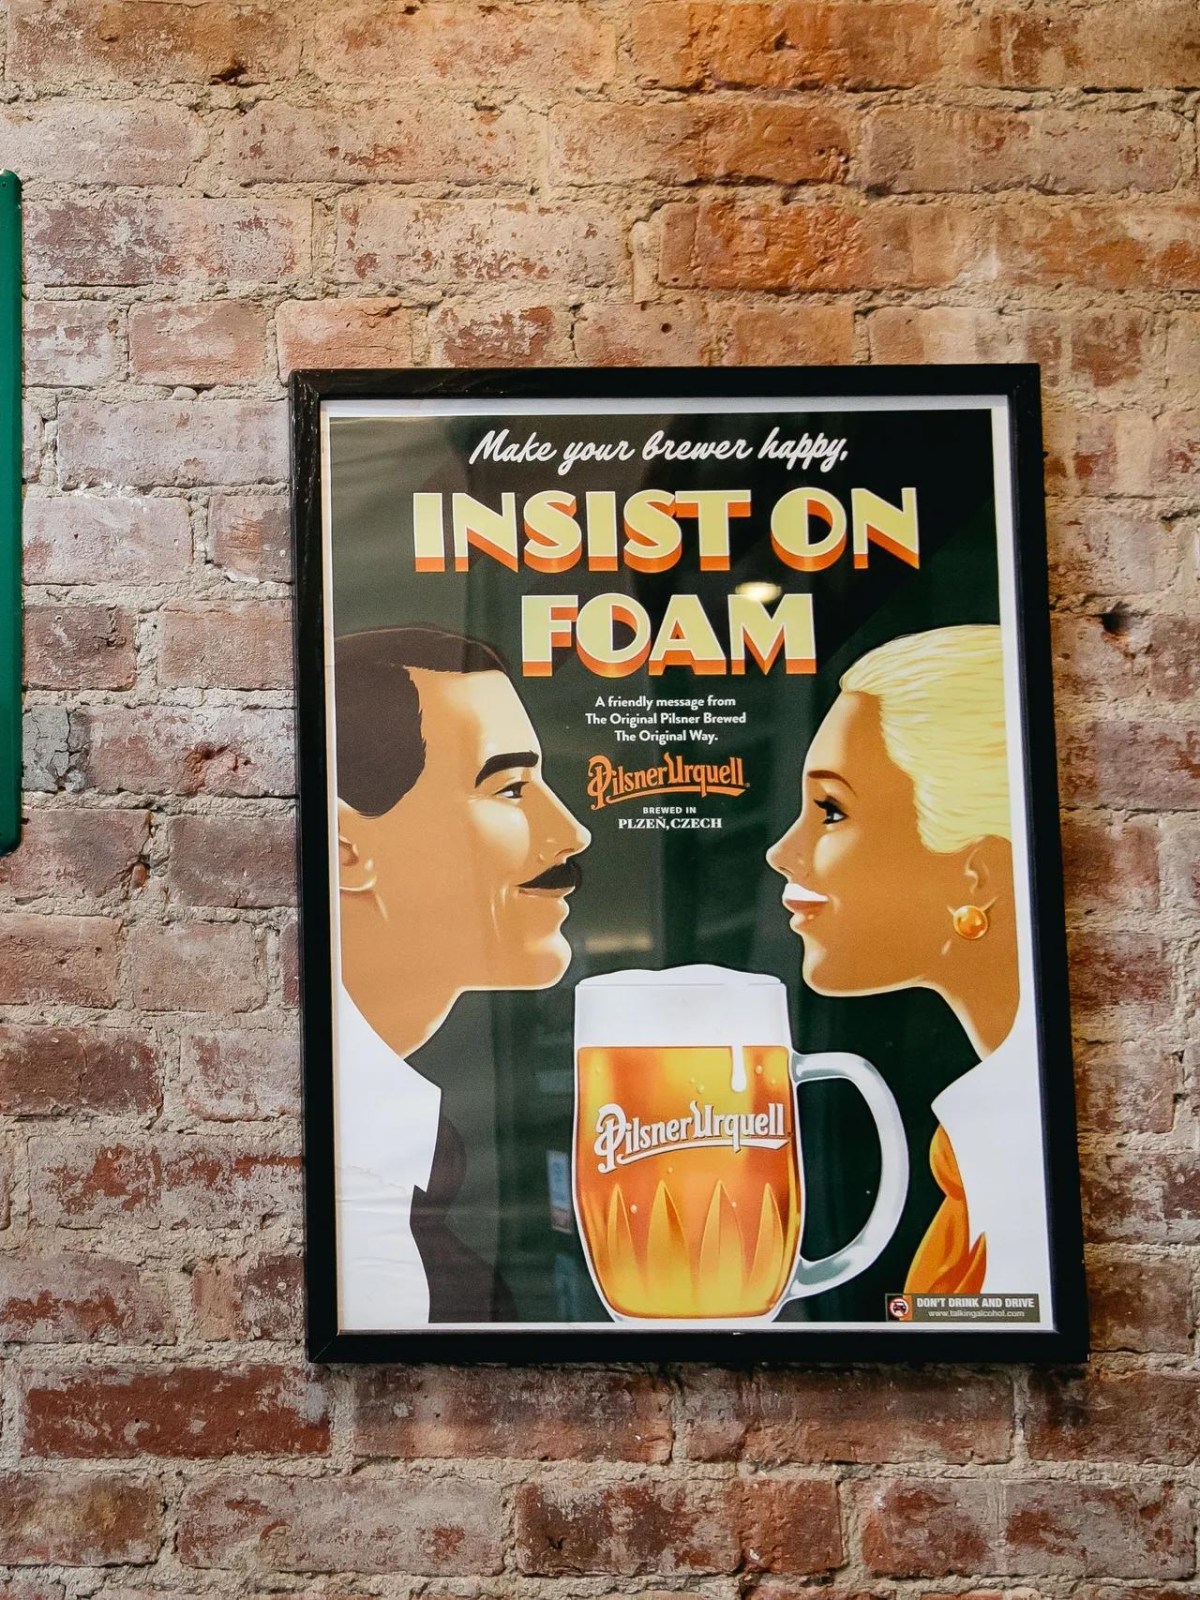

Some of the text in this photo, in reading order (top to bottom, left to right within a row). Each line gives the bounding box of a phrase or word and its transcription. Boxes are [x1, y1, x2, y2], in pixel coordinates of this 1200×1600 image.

[469, 428, 557, 465] Make
[557, 437, 635, 476] your
[641, 429, 754, 462] brewer
[412, 486, 920, 574] INSIST ON
[520, 591, 818, 678] FOAM
[594, 694, 737, 711] A friendly message from
[585, 711, 747, 728] The Original Pilsner Brewed
[614, 729, 719, 746] The Original Way.
[586, 751, 746, 811] Pilsner Urquell
[642, 806, 697, 815] BREWED IN
[593, 1100, 786, 1174] Pilsner Urquell
[916, 1297, 1035, 1308] DON'T DRINK AND DRIVE
[927, 1309, 1025, 1319] www.talkingalcohol.com
